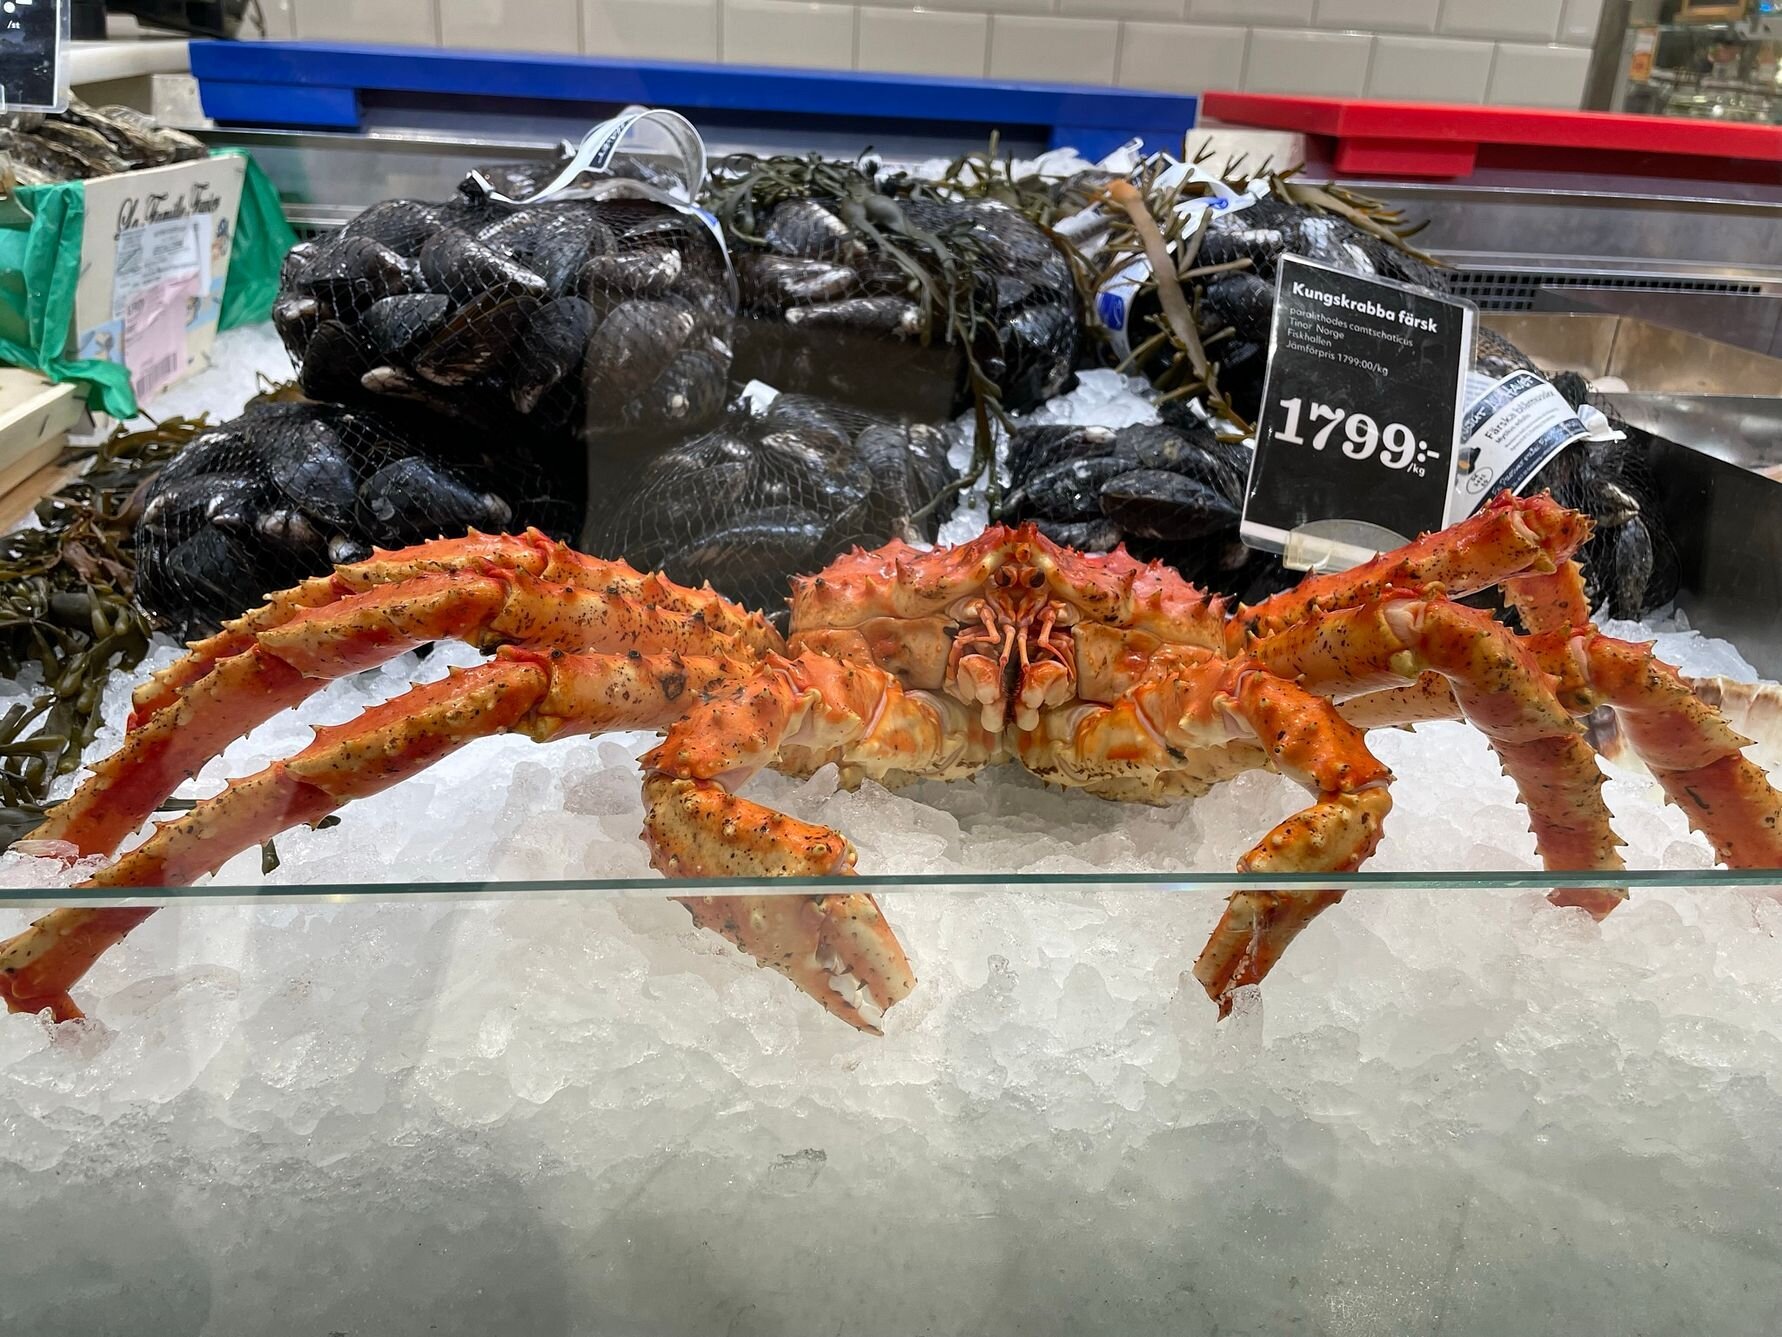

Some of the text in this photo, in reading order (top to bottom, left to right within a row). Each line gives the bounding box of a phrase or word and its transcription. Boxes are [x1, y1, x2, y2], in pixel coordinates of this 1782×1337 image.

[1292, 281, 1438, 334] Kungskrabba färsk
[1287, 328, 1332, 348] Fiskhallen
[1289, 307, 1414, 348] paralithodes camtschaticus
[1316, 324, 1345, 340] Norge
[1286, 340, 1336, 361] Jämförpris
[1274, 397, 1440, 469] 1799:-
[1406, 462, 1426, 478] /kg
